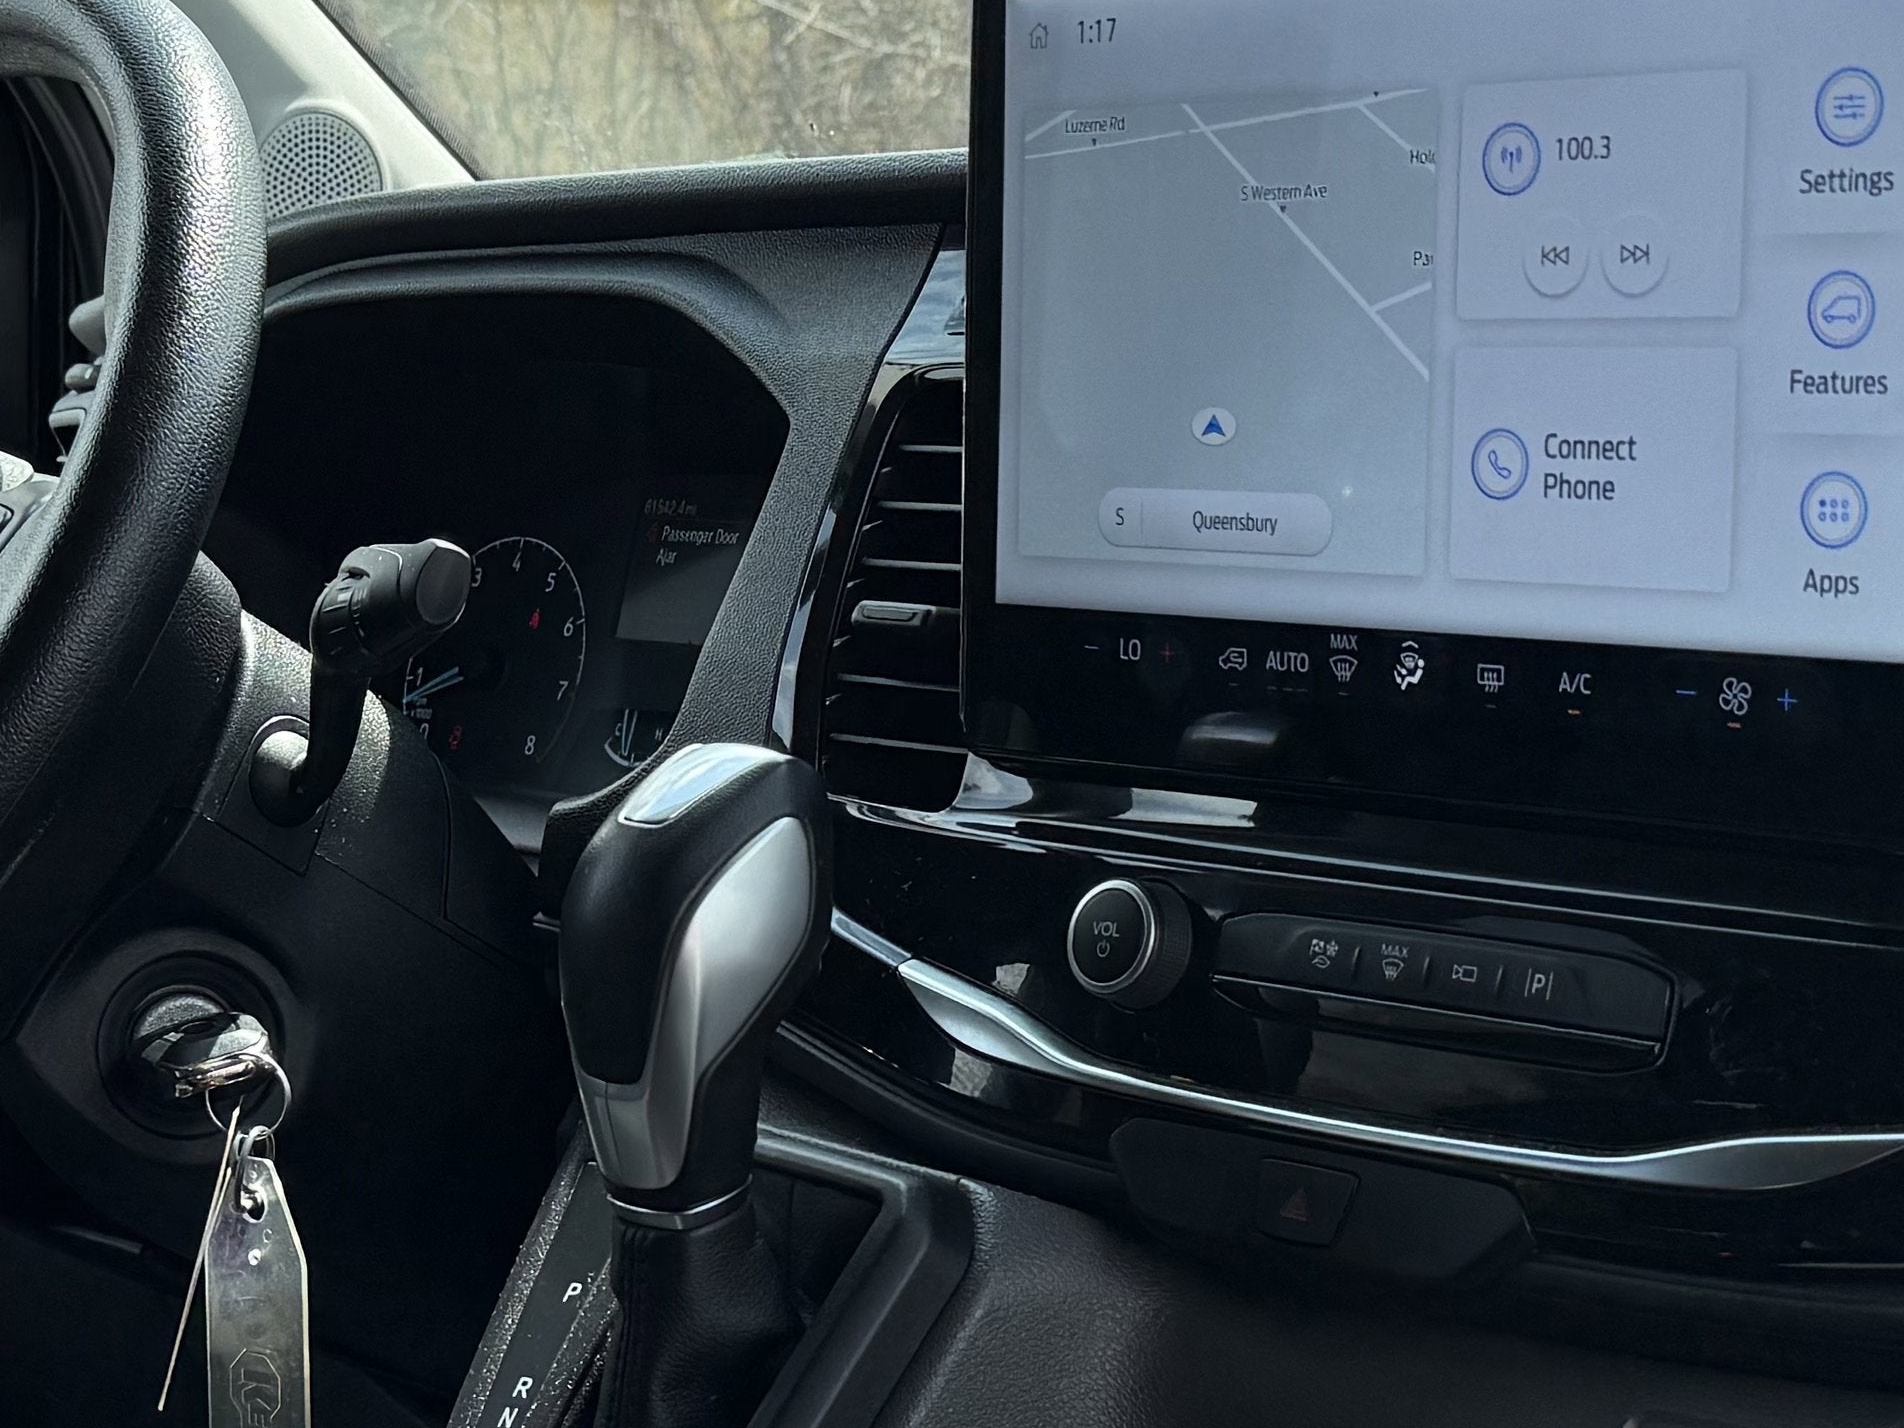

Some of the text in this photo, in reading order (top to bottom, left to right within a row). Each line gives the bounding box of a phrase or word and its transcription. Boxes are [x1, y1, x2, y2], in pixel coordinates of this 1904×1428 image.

[1078, 18, 1117, 44] 1:17
[1110, 116, 1125, 131] Rd
[1556, 135, 1611, 161] 100.3
[1240, 183, 1328, 201] S Western Ave
[1799, 167, 1895, 197] Settings
[1789, 369, 1889, 395] Features
[1544, 432, 1638, 462] Connect
[1543, 472, 1616, 501] Phone
[1115, 507, 1278, 536] S Queensbury
[715, 528, 740, 545] Door
[511, 555, 522, 573] 4
[545, 572, 557, 593] 5
[1802, 567, 1860, 599] Apps
[563, 616, 575, 637] 6
[1119, 637, 1142, 661] LO
[1329, 632, 1359, 652] MAX
[1265, 651, 1310, 673] AUTO
[557, 680, 569, 701] 7
[1558, 671, 1592, 695] A/C
[524, 734, 536, 756] 8
[1092, 920, 1120, 938] VOL
[1380, 942, 1410, 958] MAX
[562, 1281, 583, 1303] P
[511, 1376, 534, 1400] R
